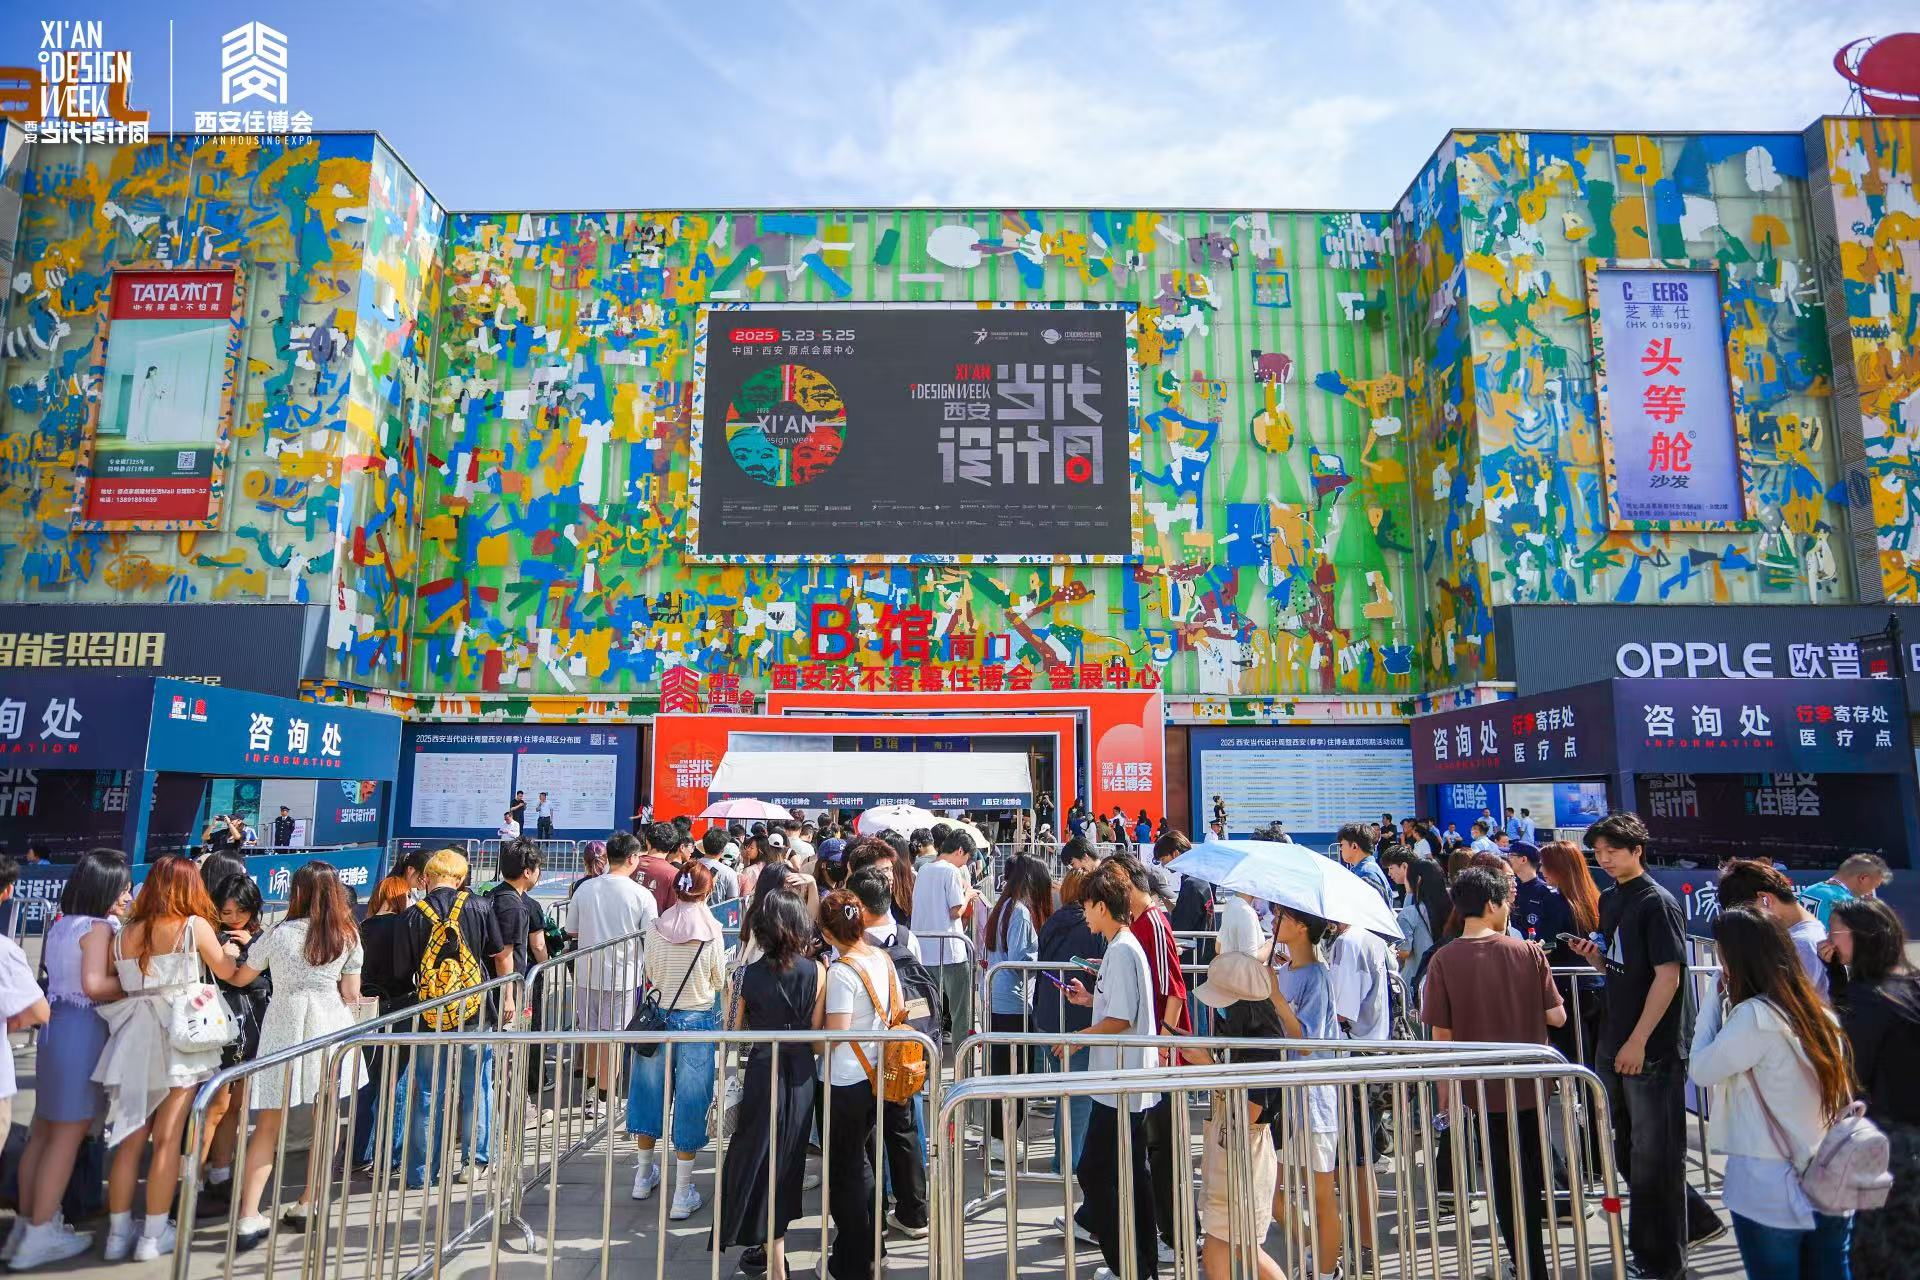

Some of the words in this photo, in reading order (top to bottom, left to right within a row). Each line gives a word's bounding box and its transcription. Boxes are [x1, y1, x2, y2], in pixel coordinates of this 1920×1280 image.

[1623, 281, 1689, 302] CEERS
[1625, 305, 1690, 320] 芝華仕
[1626, 321, 1648, 330] (HK
[1651, 321, 1692, 330] 01999)
[735, 331, 775, 341] 2025
[788, 345, 855, 356] 原点会展中心
[955, 363, 992, 381] XI'AN
[957, 383, 992, 400] WEEK
[996, 363, 1104, 424] 当代
[943, 401, 991, 422] 西安
[1641, 337, 1693, 473] 头等舱
[757, 415, 816, 433] XI'AN
[791, 436, 815, 444] week
[937, 426, 1105, 487] 设计周
[1648, 475, 1690, 489] 沙发
[809, 603, 935, 662] B馆
[948, 631, 1011, 661] 南门
[1615, 642, 1774, 678] OPPLE
[708, 673, 740, 688] 西安
[771, 664, 1033, 692] 西安永不落幕住博会
[1048, 663, 1162, 690] 会展中心
[708, 689, 755, 705] 住博会
[1511, 704, 1576, 736] 行李寄存处
[1643, 703, 1773, 738] 咨询处
[1795, 704, 1889, 724] 行李寄存处
[248, 712, 342, 757] 咨询处
[1432, 719, 1498, 761] 咨询处
[1645, 739, 1775, 748] INFORMATION
[1799, 729, 1892, 748] 医疗点
[1513, 736, 1577, 763] 医疗点
[245, 752, 342, 768] INFORMATION
[1756, 788, 1821, 816] 住博会
